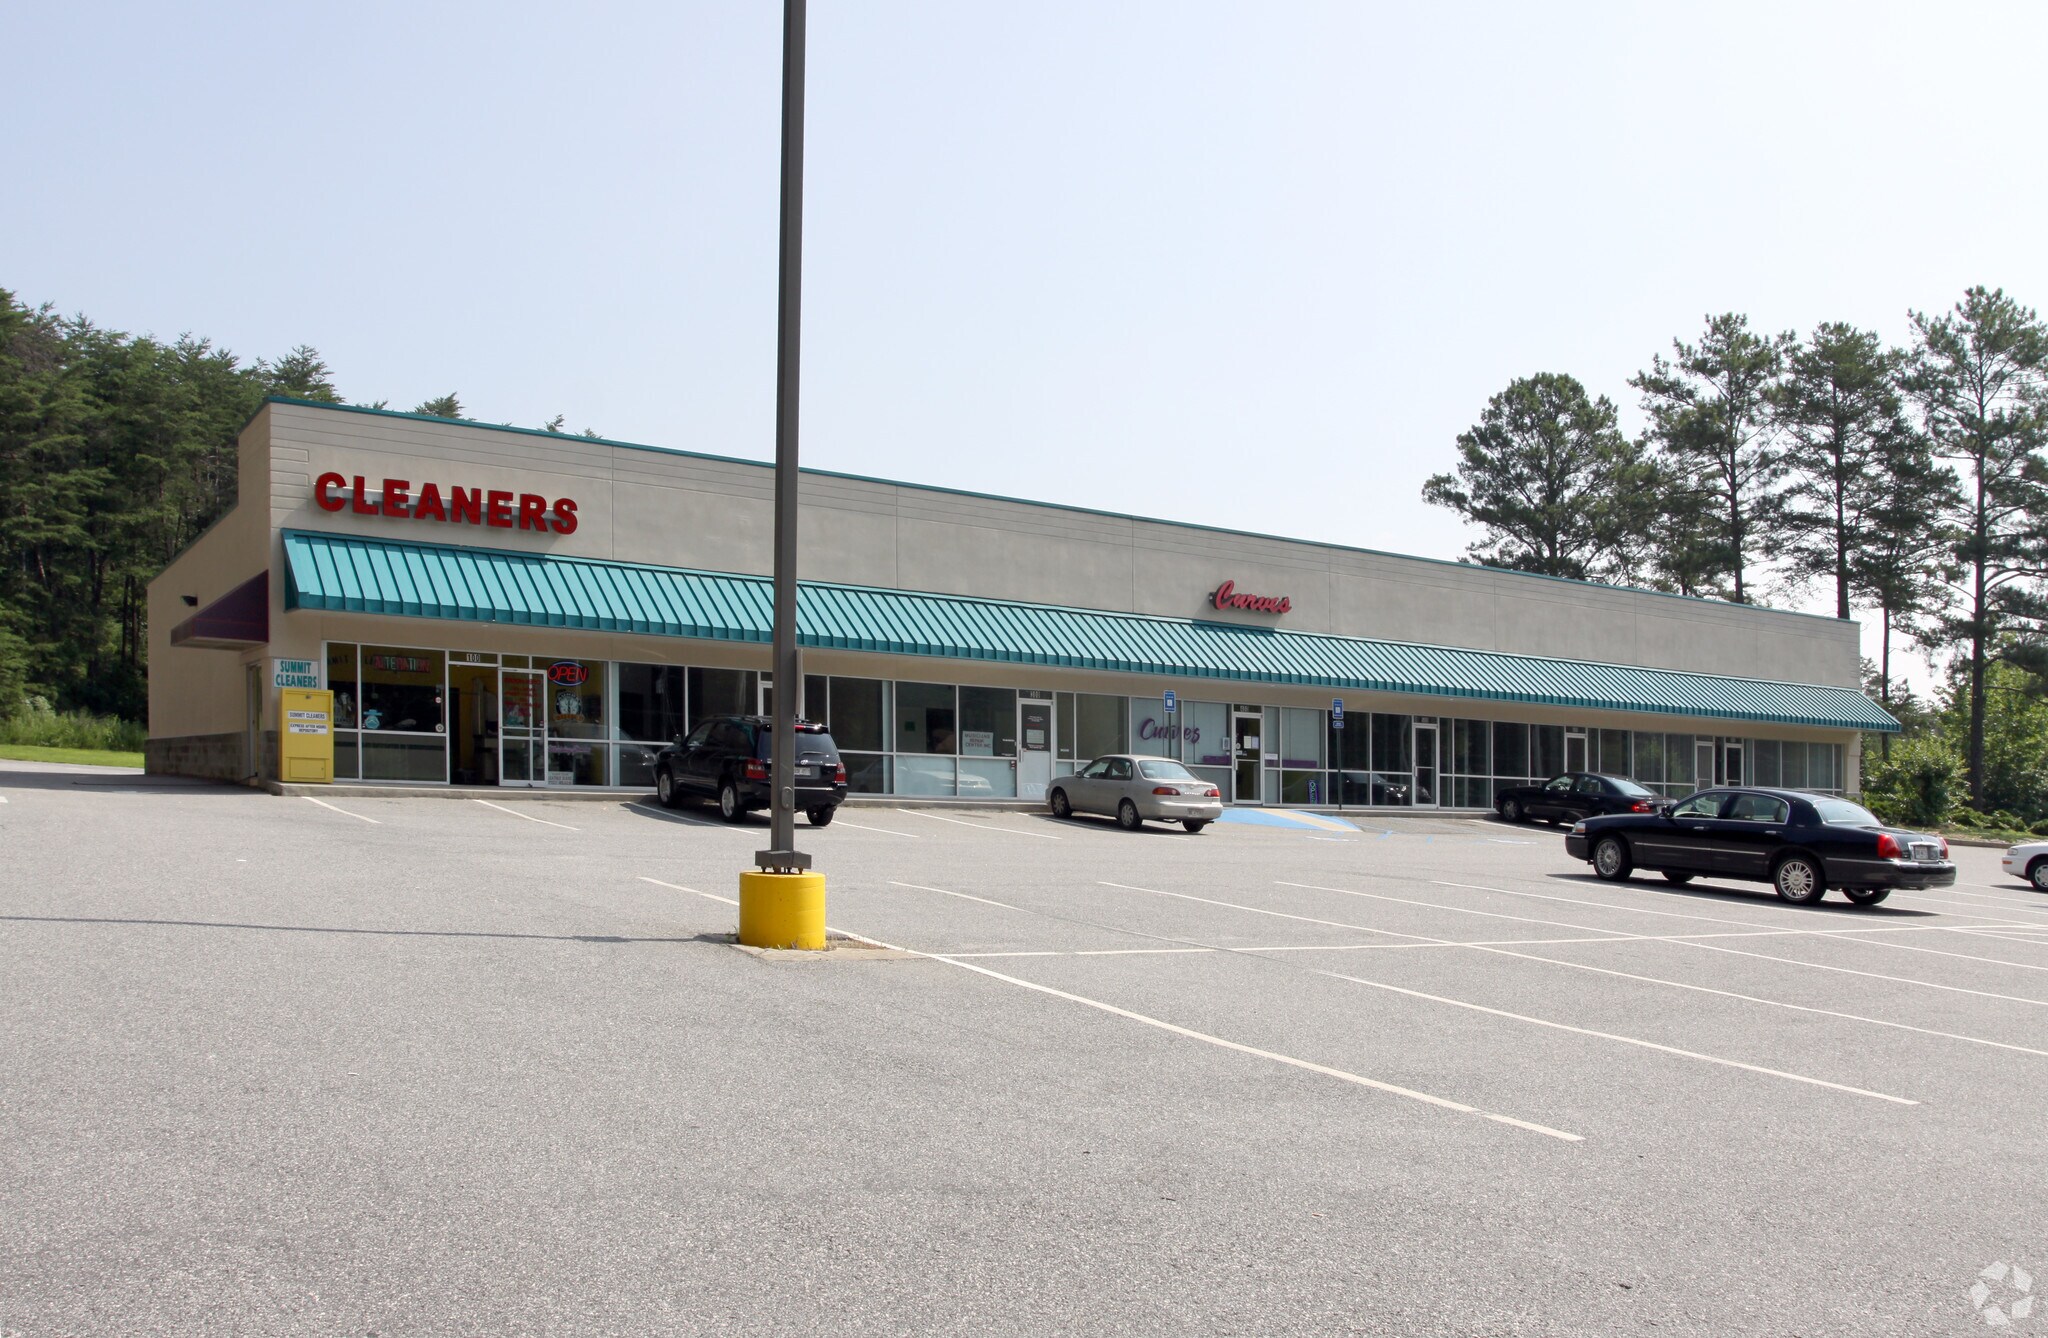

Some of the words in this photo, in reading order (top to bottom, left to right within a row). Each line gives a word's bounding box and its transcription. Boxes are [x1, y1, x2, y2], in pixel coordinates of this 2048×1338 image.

[314, 472, 578, 535] CLEANERS
[1215, 580, 1292, 613] Curves
[466, 653, 481, 663] 100
[280, 660, 312, 674] SUMMIT
[547, 665, 588, 682] OPEN
[275, 674, 317, 688] CLEANERS
[1140, 718, 1200, 744] Curves
